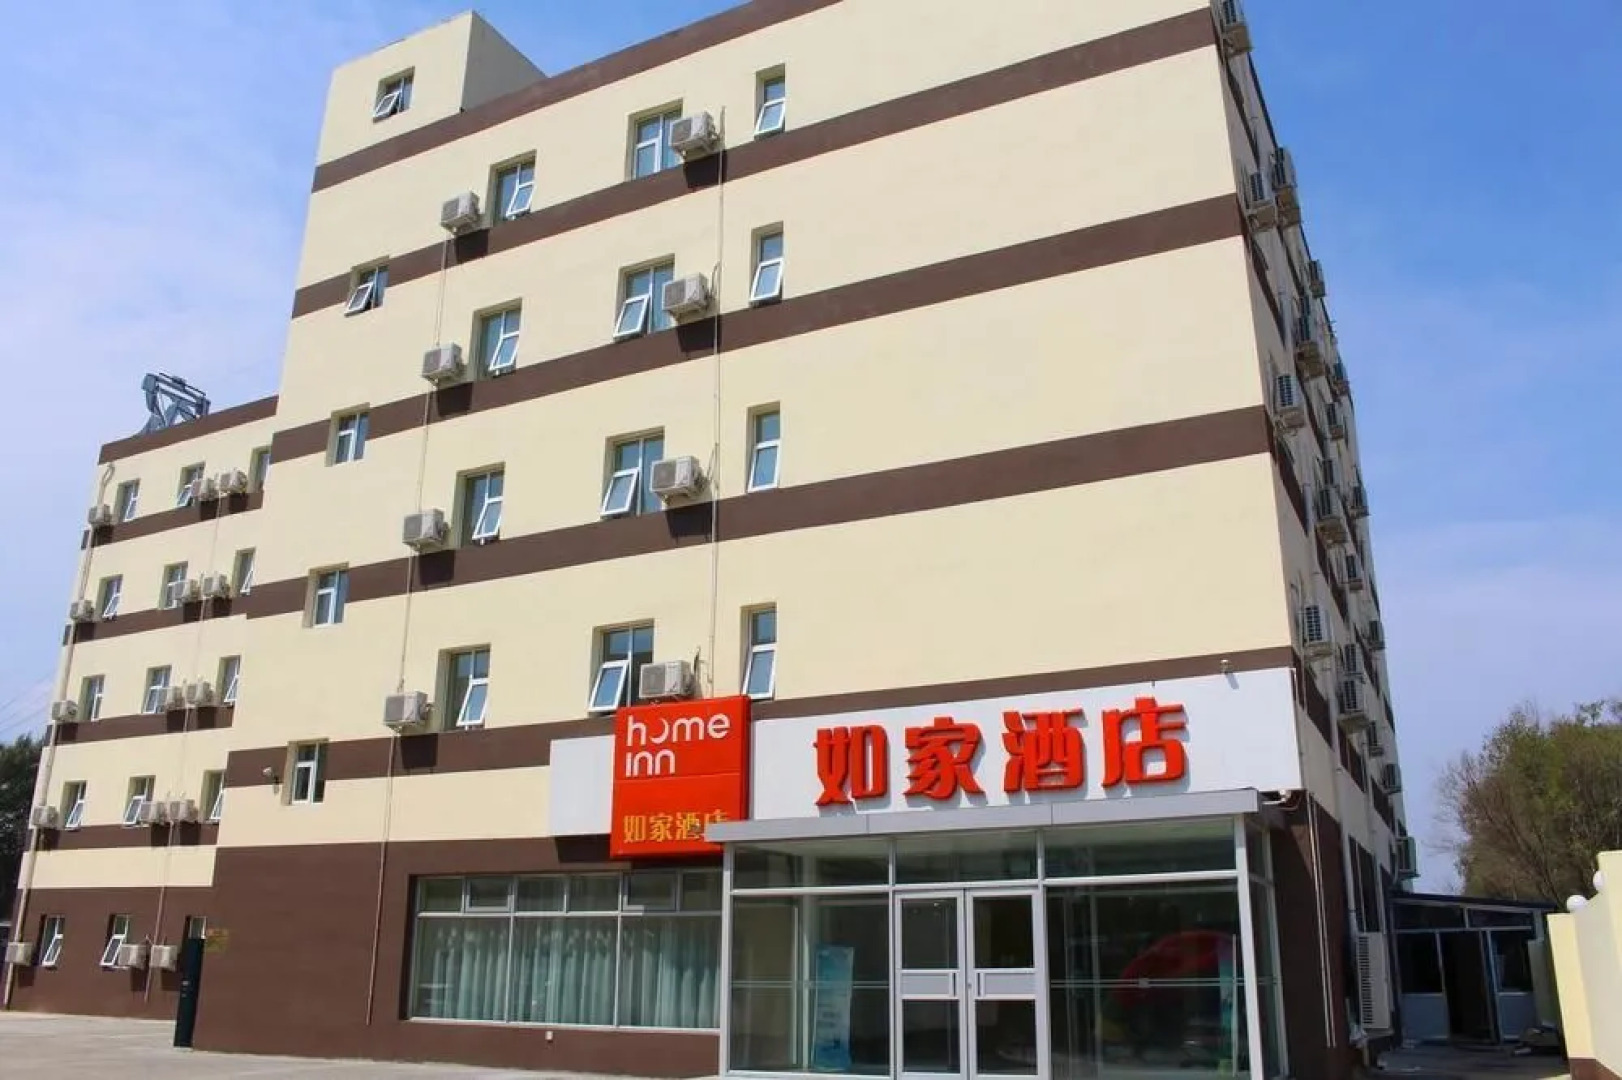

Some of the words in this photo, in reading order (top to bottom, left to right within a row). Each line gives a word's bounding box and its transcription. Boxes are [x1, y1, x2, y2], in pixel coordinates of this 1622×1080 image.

[626, 713, 731, 746] home
[625, 749, 676, 777] inn
[813, 696, 1188, 806] 如家酒店
